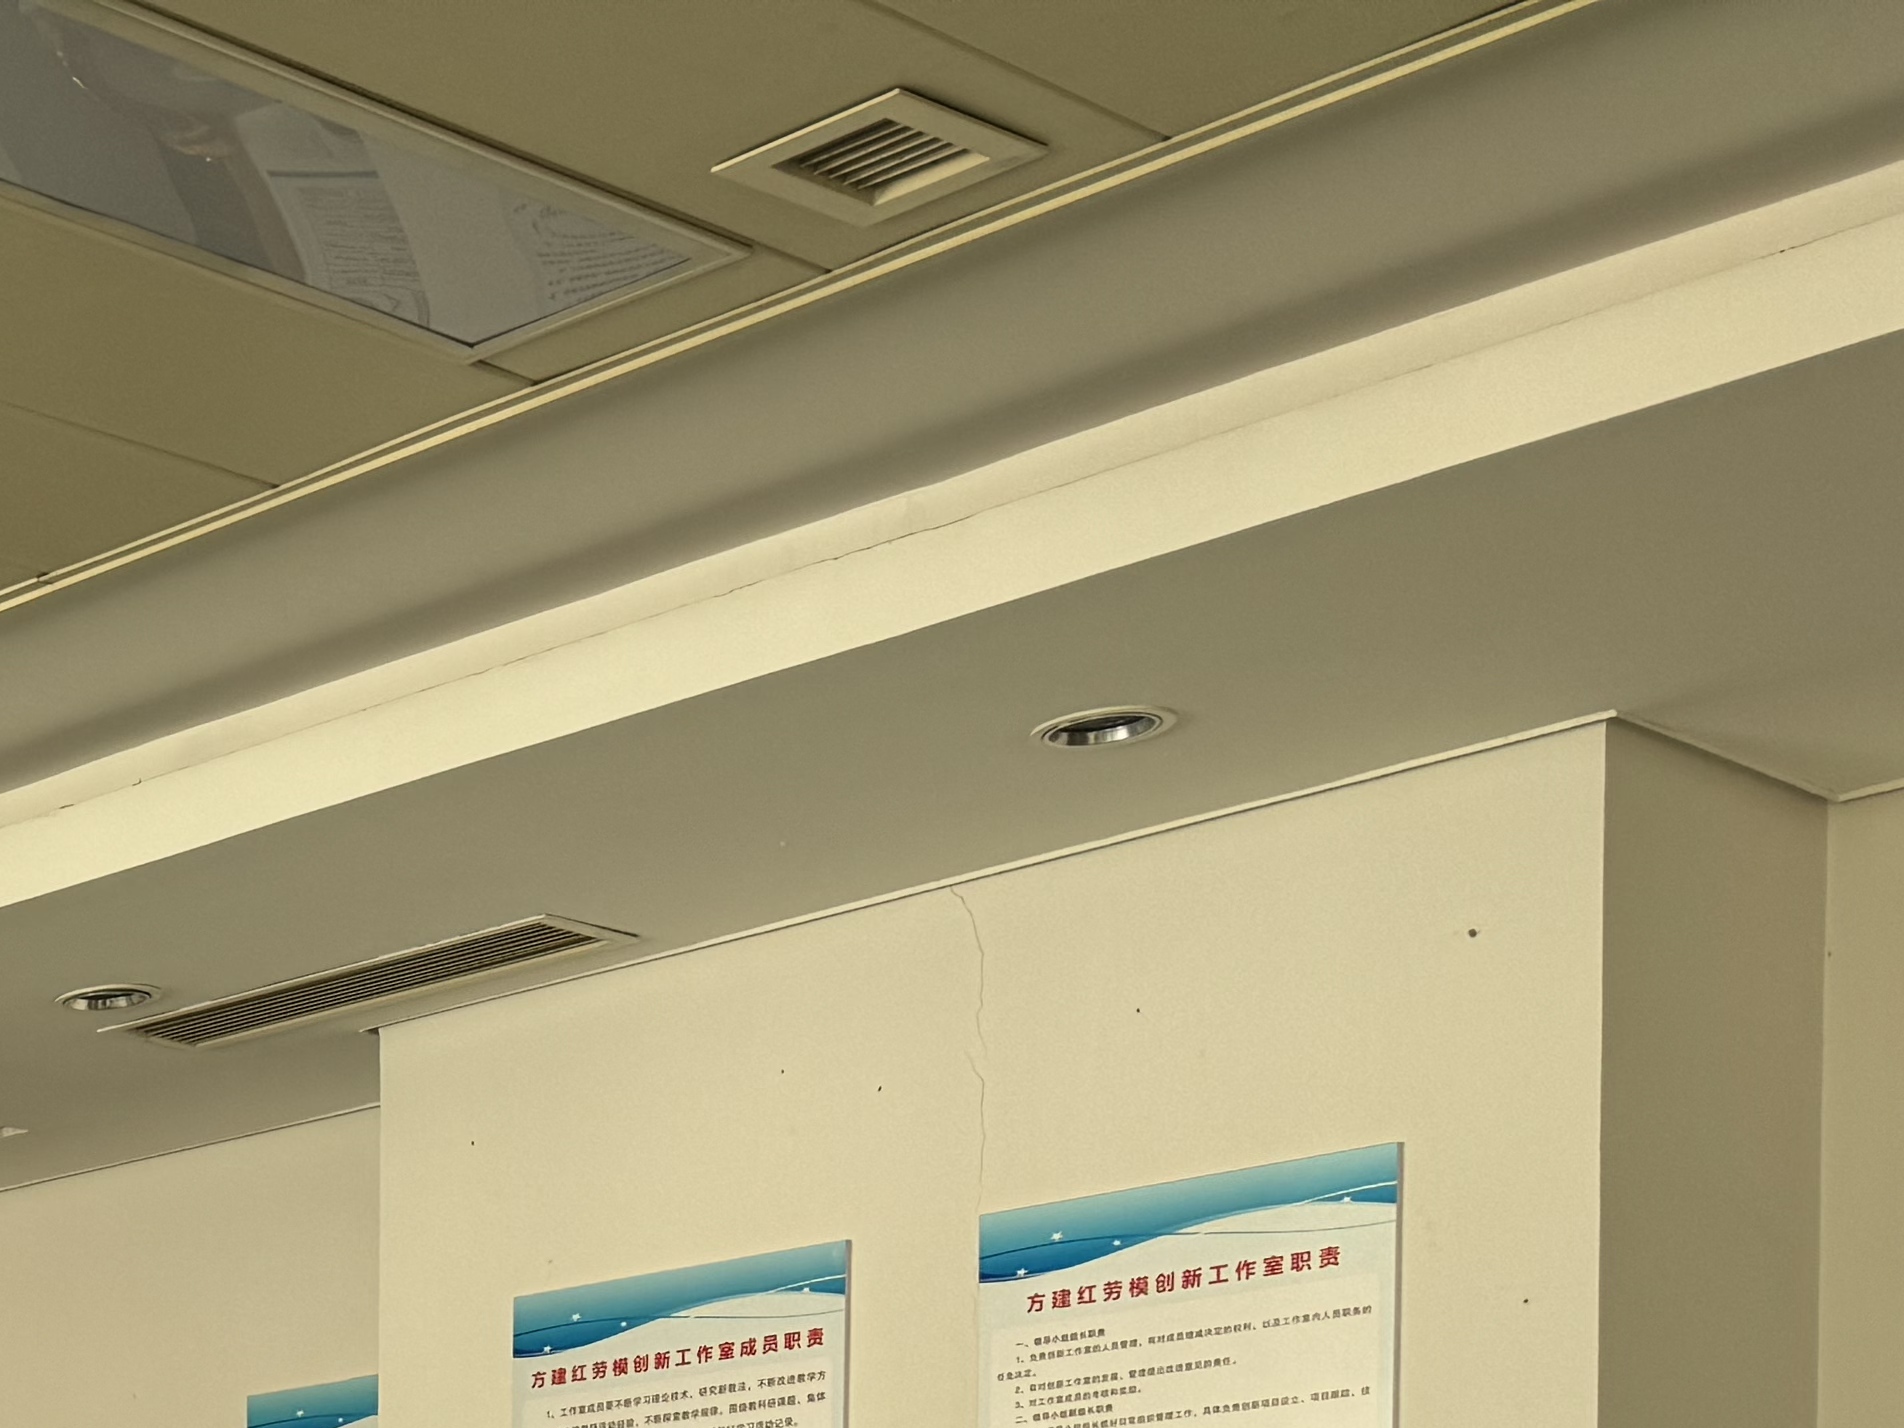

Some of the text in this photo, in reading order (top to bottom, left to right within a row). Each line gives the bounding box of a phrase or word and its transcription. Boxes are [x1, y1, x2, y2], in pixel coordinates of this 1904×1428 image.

[1026, 1244, 1341, 1314] 方建红劳模创新工作室职责
[531, 1326, 824, 1390] 方建红劳模创新工作室成员职责
